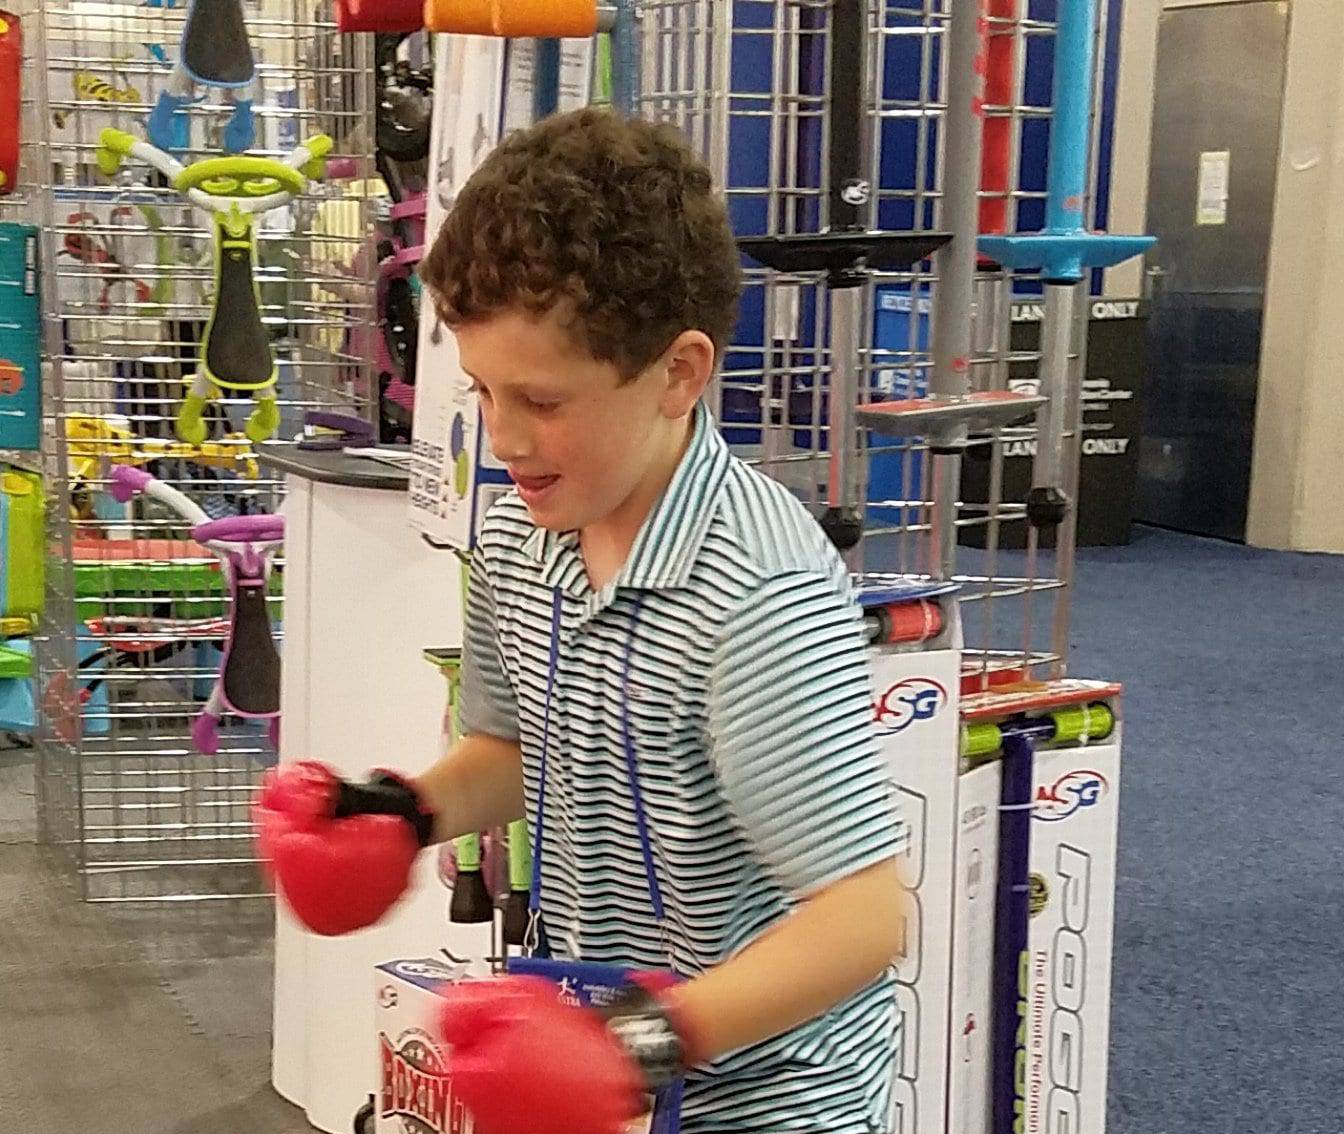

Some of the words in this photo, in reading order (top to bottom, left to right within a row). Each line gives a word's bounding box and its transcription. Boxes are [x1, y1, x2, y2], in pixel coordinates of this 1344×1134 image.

[1091, 302, 1139, 318] ONLY
[1083, 438, 1129, 454] ONLY
[1033, 950, 1047, 978] The
[1030, 981, 1046, 1048] Ultimate
